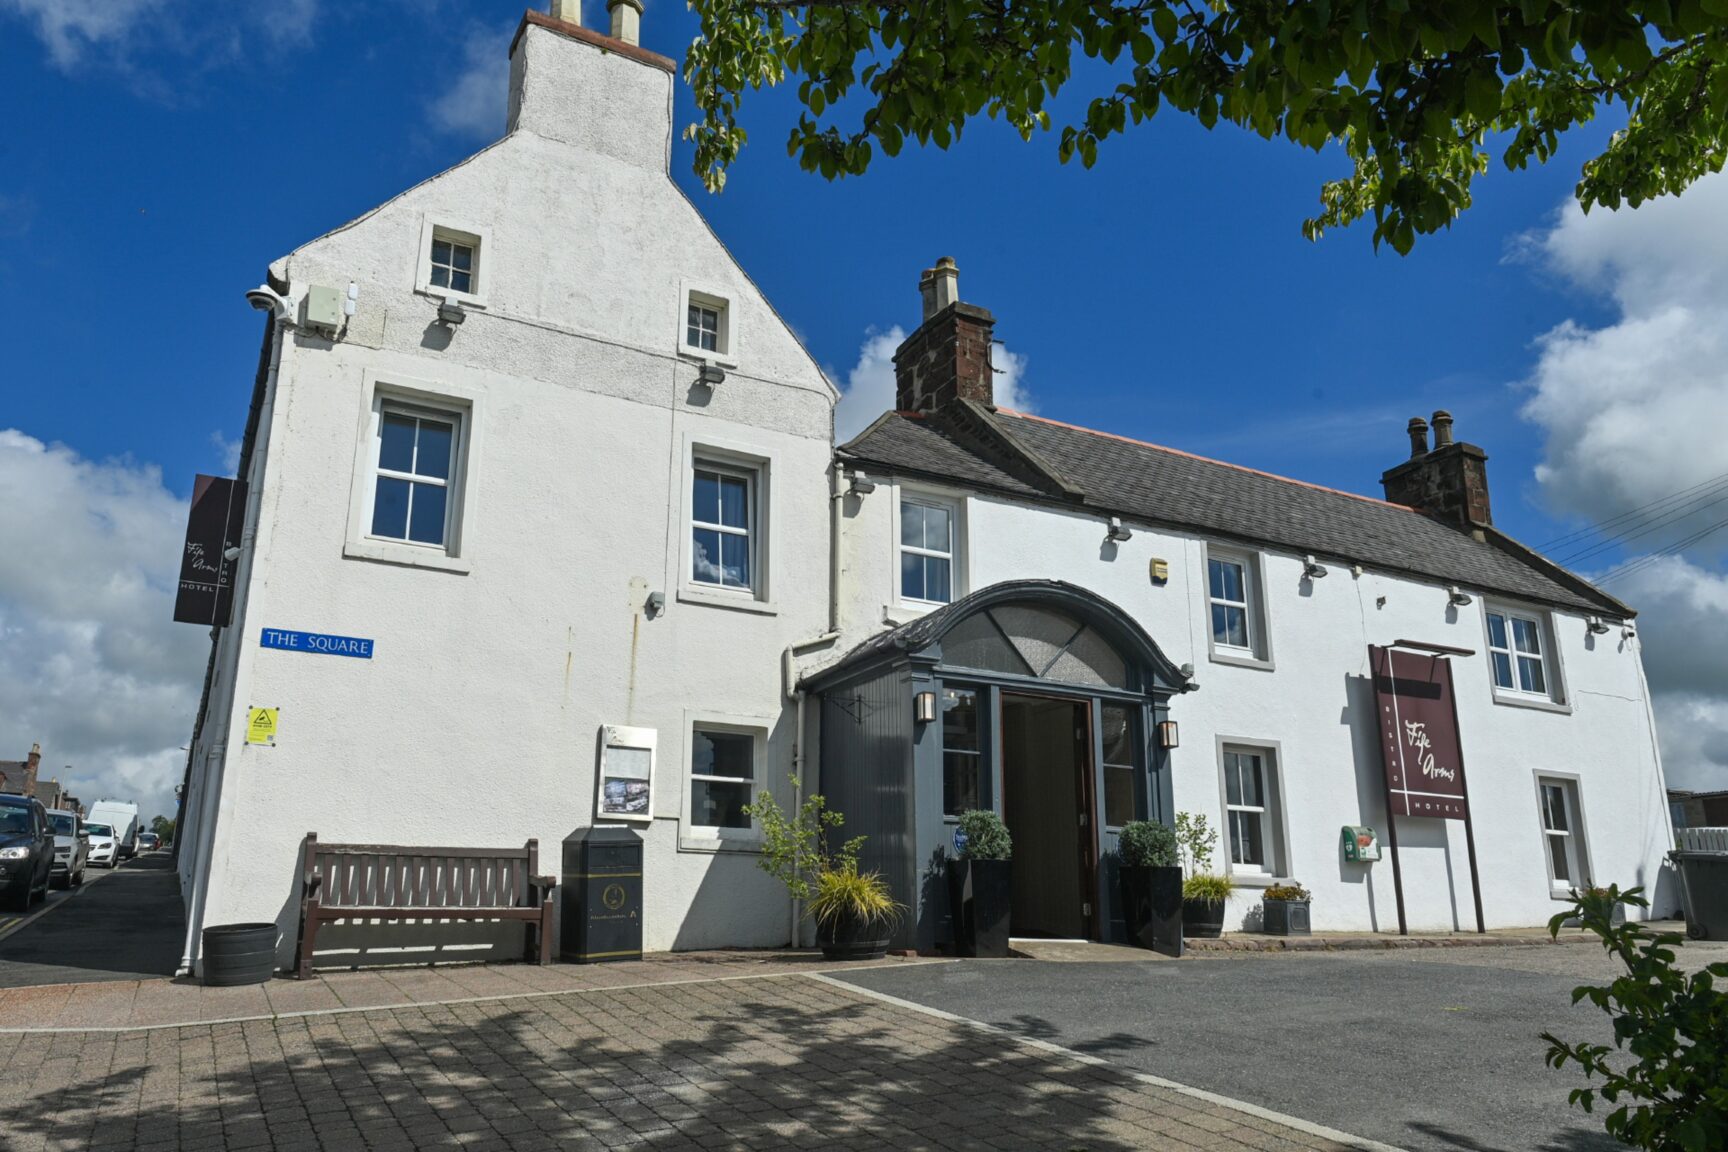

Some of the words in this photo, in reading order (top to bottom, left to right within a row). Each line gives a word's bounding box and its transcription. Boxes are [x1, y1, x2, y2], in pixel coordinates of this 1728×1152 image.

[187, 541, 204, 562] Fife
[221, 541, 232, 583] BTRO
[192, 559, 218, 573] Arms
[181, 583, 214, 592] HOTEL
[267, 631, 298, 646] THE
[308, 636, 368, 654] SQUARE
[1385, 706, 1398, 781] BISTRO
[1405, 719, 1431, 765] Fife
[1423, 753, 1455, 782] Arms
[1415, 803, 1459, 812] HOTEL
